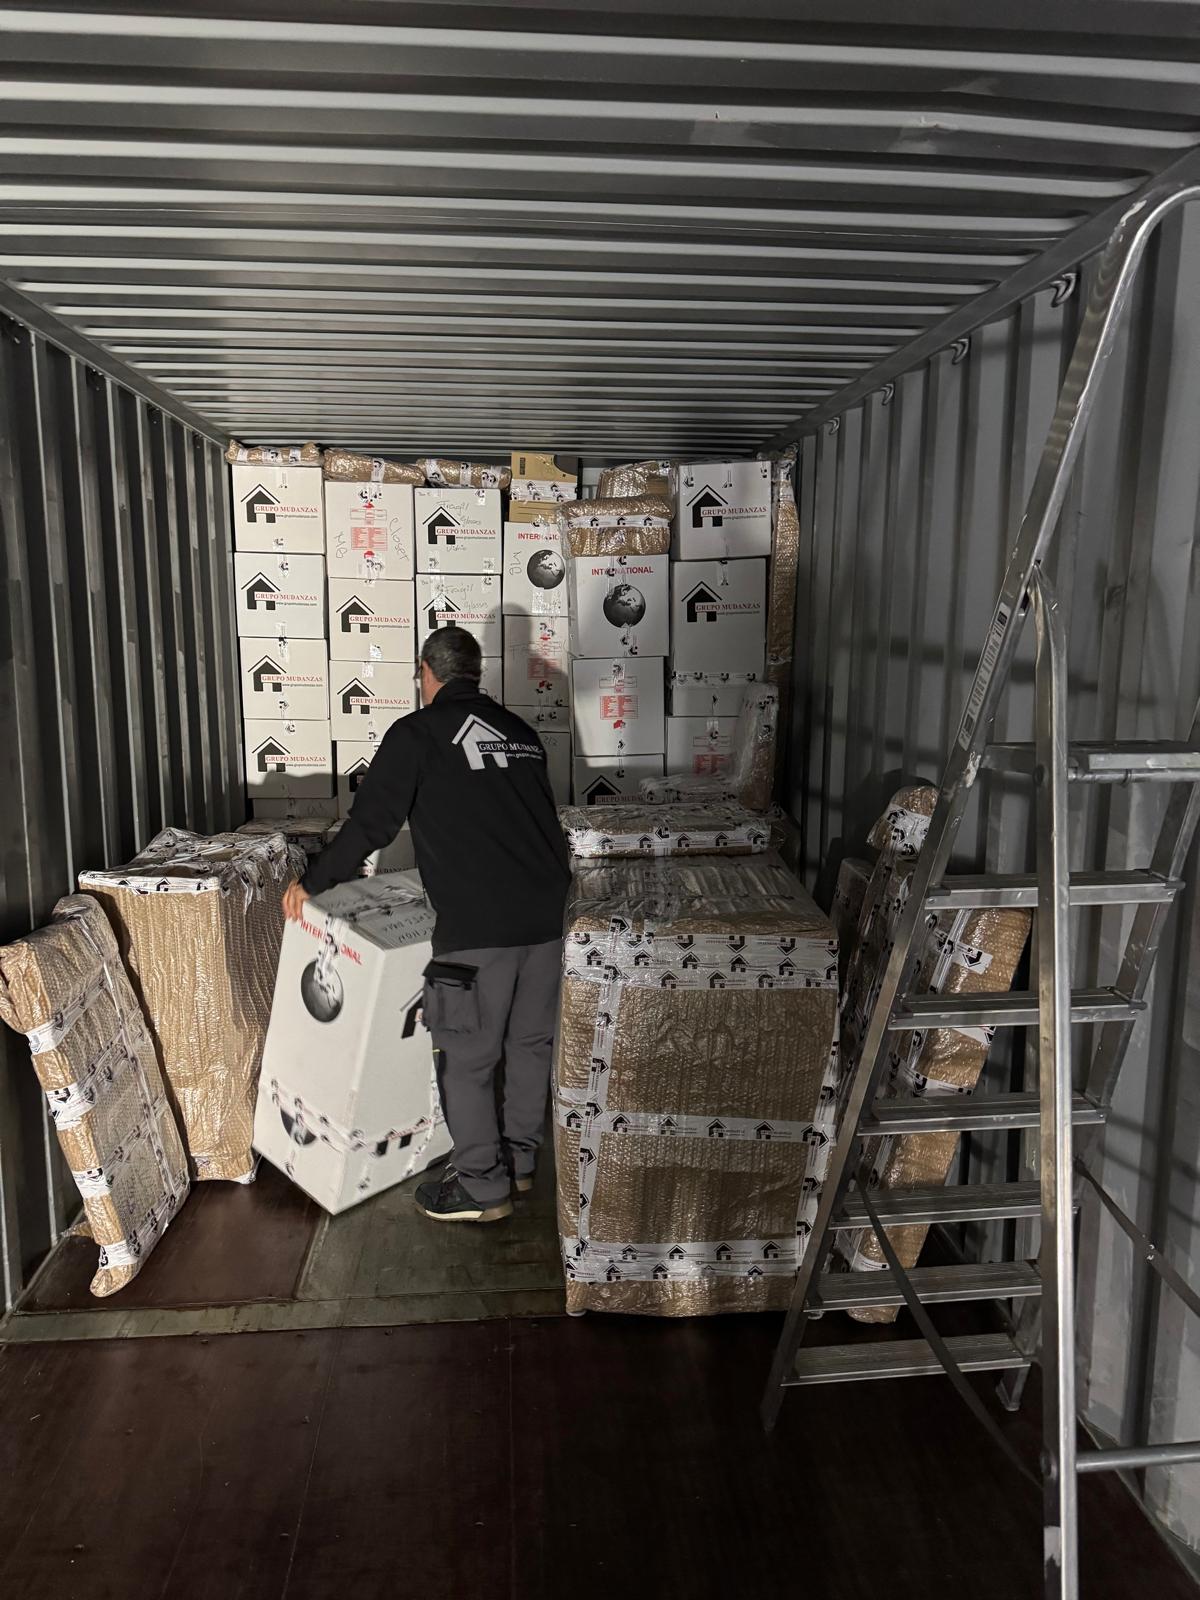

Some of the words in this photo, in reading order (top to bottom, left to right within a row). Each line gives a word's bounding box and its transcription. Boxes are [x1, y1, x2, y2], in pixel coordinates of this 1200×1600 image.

[255, 505, 279, 513] GRUPO
[702, 508, 727, 516] GRUPO
[728, 506, 767, 514] MUDANZAS
[722, 602, 761, 610] MUDANZAS
[479, 743, 509, 752] GRUPO
